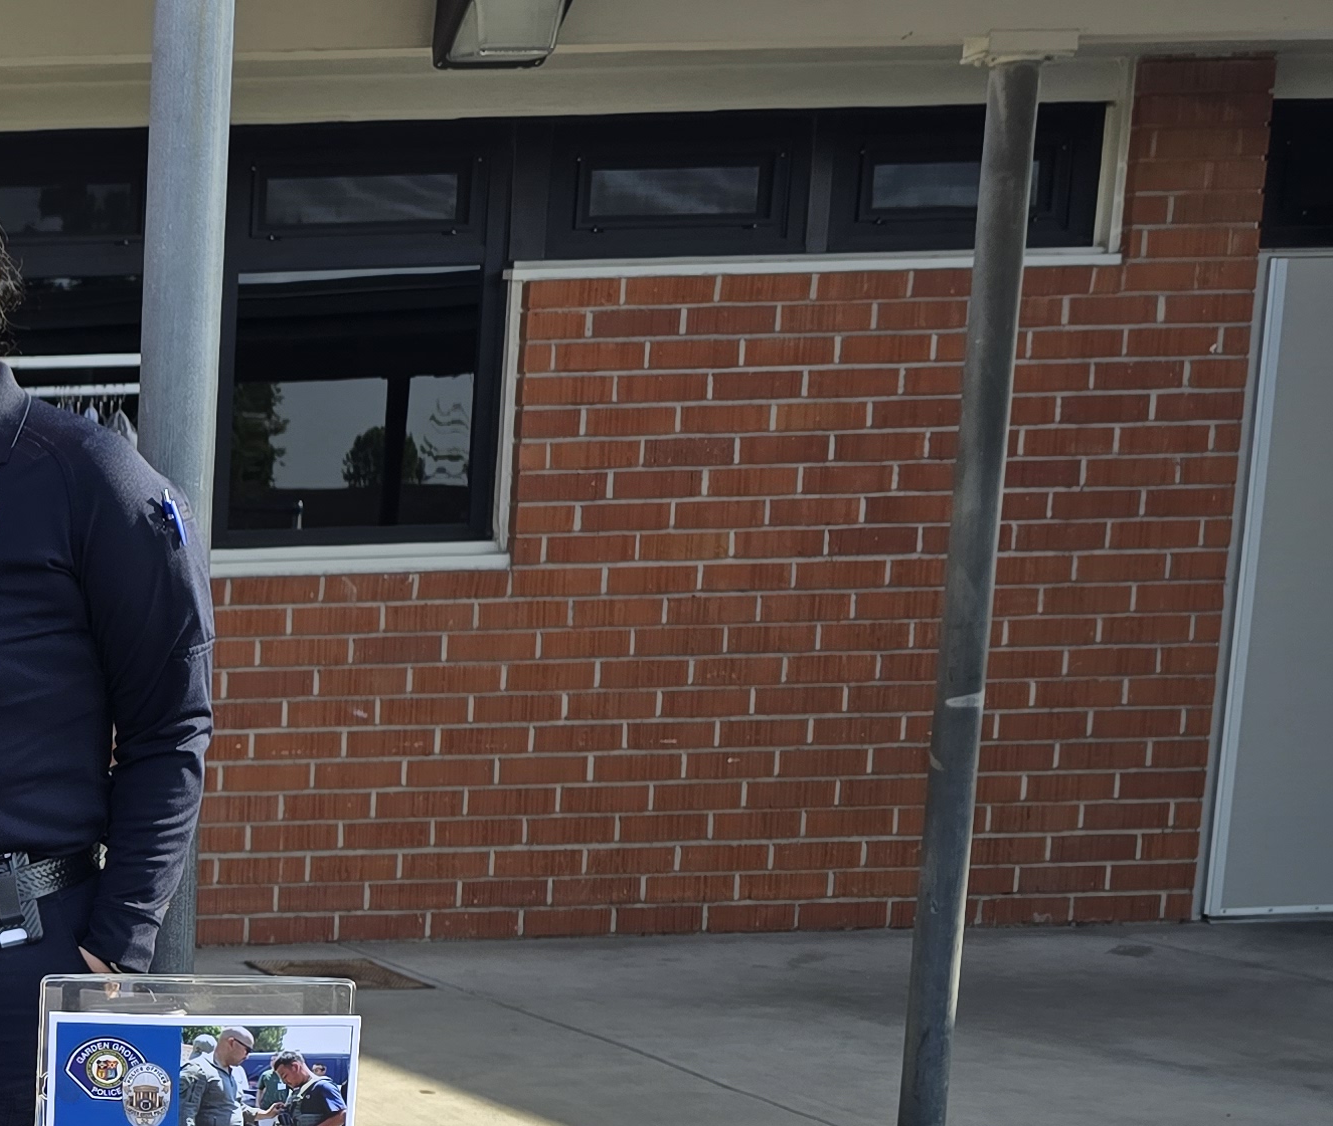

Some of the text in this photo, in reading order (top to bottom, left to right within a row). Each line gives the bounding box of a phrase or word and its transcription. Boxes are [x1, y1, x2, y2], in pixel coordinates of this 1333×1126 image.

[76, 1042, 140, 1067] GARDEN GROVE
[91, 1086, 122, 1096] POLICE
